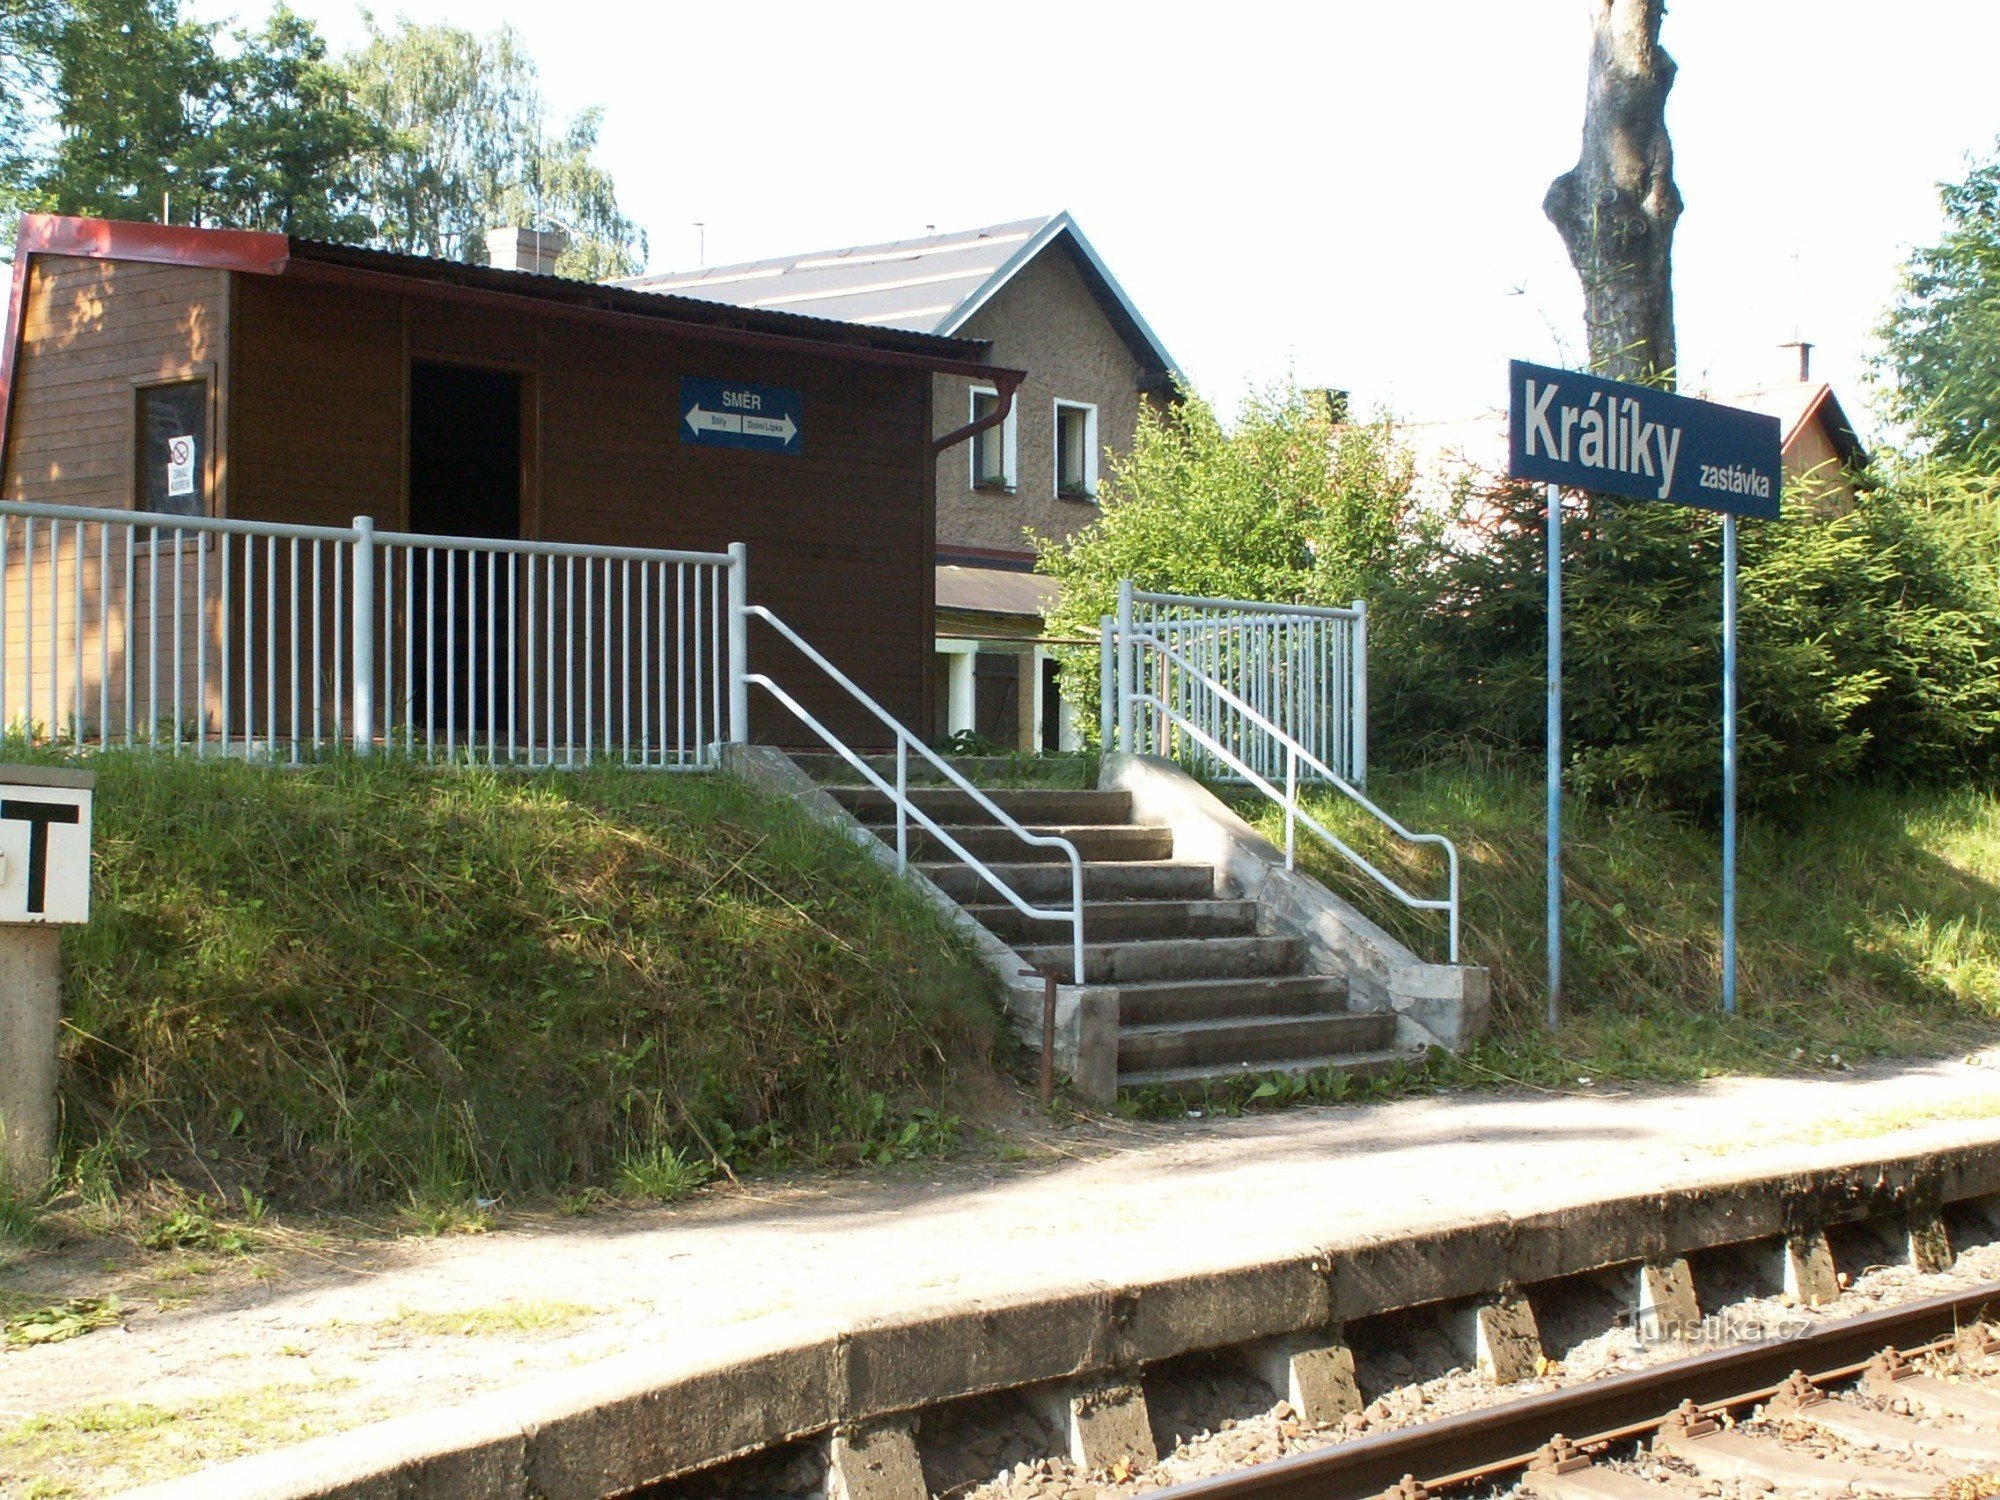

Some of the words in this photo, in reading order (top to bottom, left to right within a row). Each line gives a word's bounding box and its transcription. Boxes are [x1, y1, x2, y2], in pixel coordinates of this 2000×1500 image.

[723, 390, 761, 410] SMĚR
[1525, 379, 1682, 499] Králíky
[1700, 464, 1770, 498] zastávka
[1, 800, 79, 913] T
